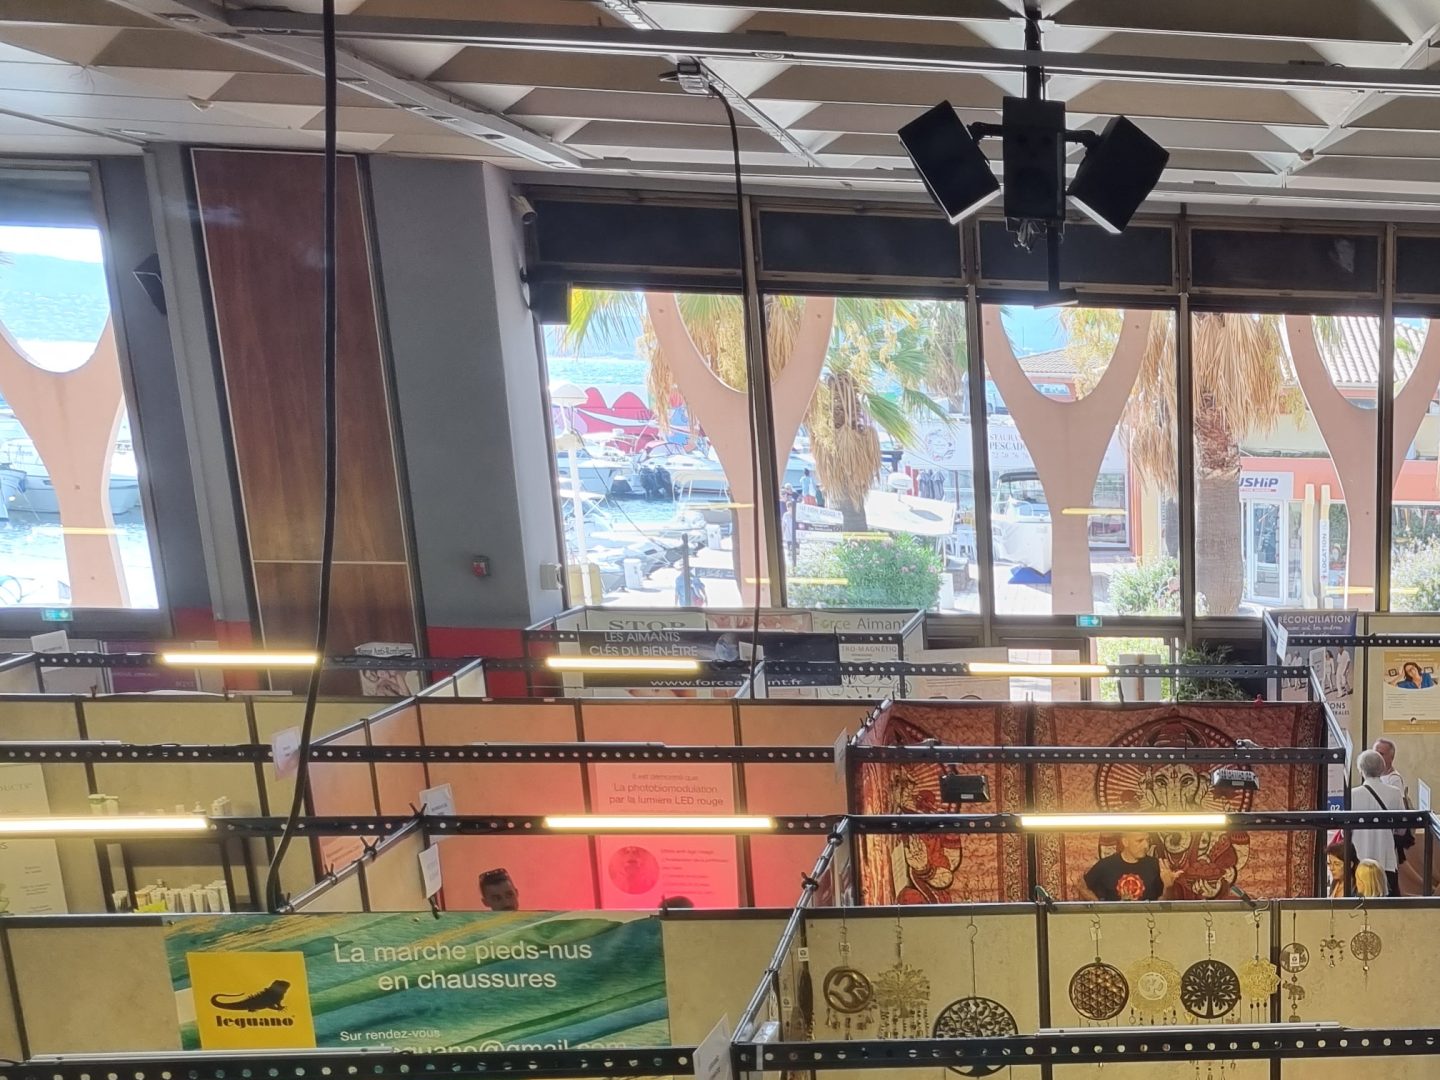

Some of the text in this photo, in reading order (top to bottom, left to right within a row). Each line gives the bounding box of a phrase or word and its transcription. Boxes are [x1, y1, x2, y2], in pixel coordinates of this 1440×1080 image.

[604, 631, 681, 642] LES AIMANTS
[589, 643, 698, 657] CLÉS DU BIEN-ÊTRE
[613, 783, 718, 794] La photobiomodulation
[609, 796, 625, 805] par
[675, 796, 695, 805] LED
[696, 797, 724, 807] rouge
[334, 940, 593, 964] La marche pieds-nus
[378, 969, 557, 991] en chaussures
[216, 1015, 294, 1029] leguano
[340, 1028, 441, 1042] Sur rendez-vous
